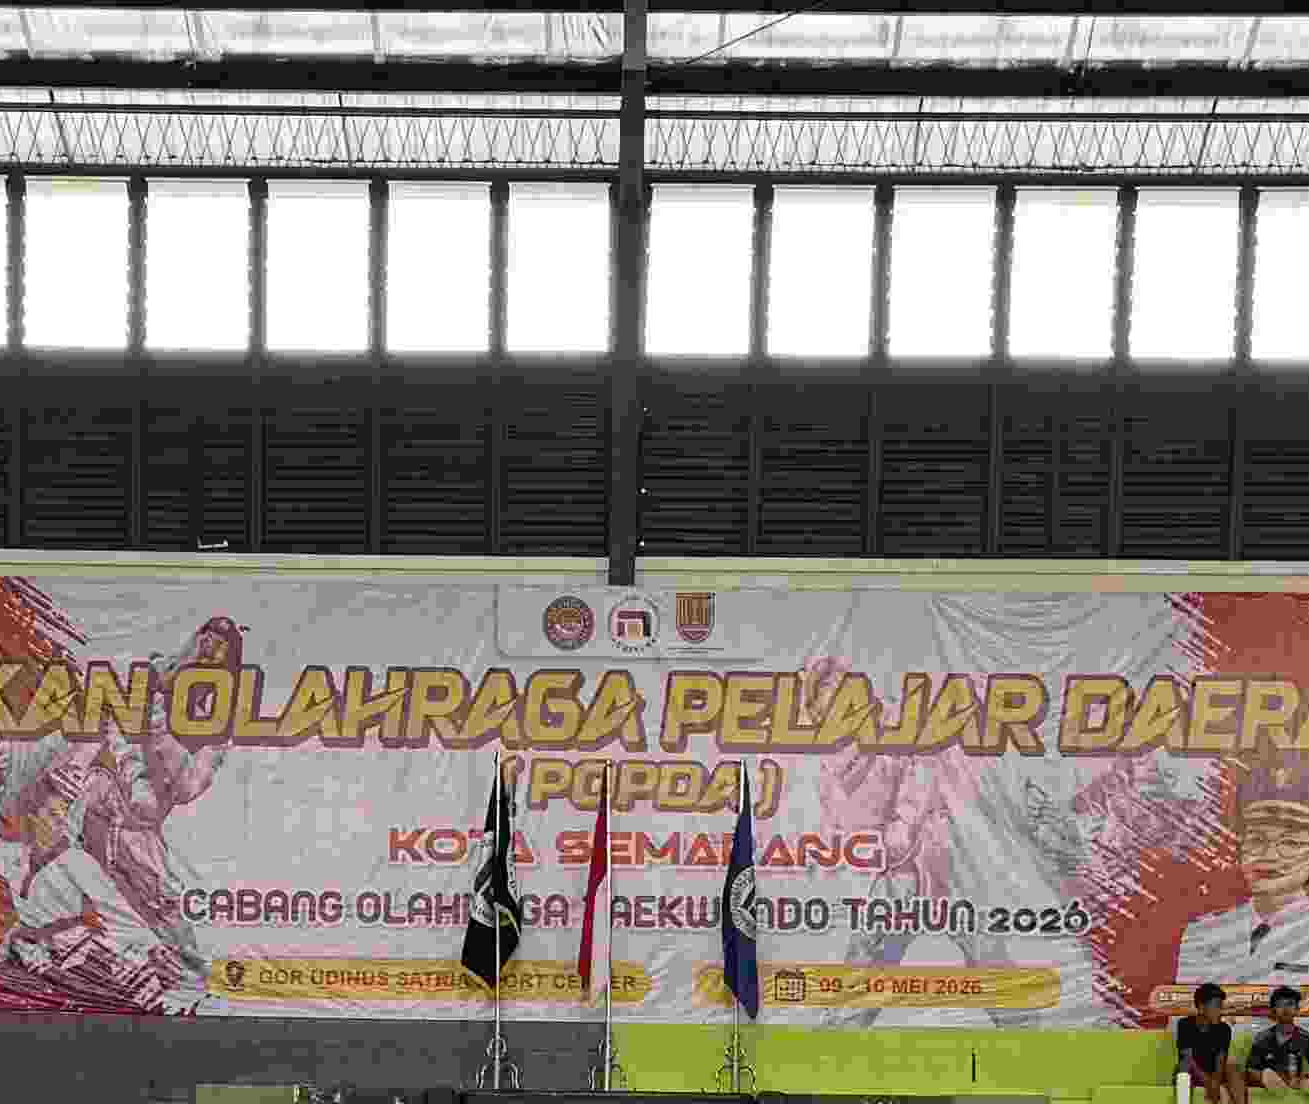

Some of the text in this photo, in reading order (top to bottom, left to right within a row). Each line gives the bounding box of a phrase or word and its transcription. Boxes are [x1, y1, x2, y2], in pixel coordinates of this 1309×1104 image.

[168, 662, 646, 751] OLAHRAGA
[660, 670, 1049, 753] PELAJAR
[184, 889, 343, 925] CABANG
[842, 897, 974, 930] TAHUN
[991, 902, 1090, 932] 2026
[259, 969, 305, 986] GOR
[892, 977, 929, 994] MEI
